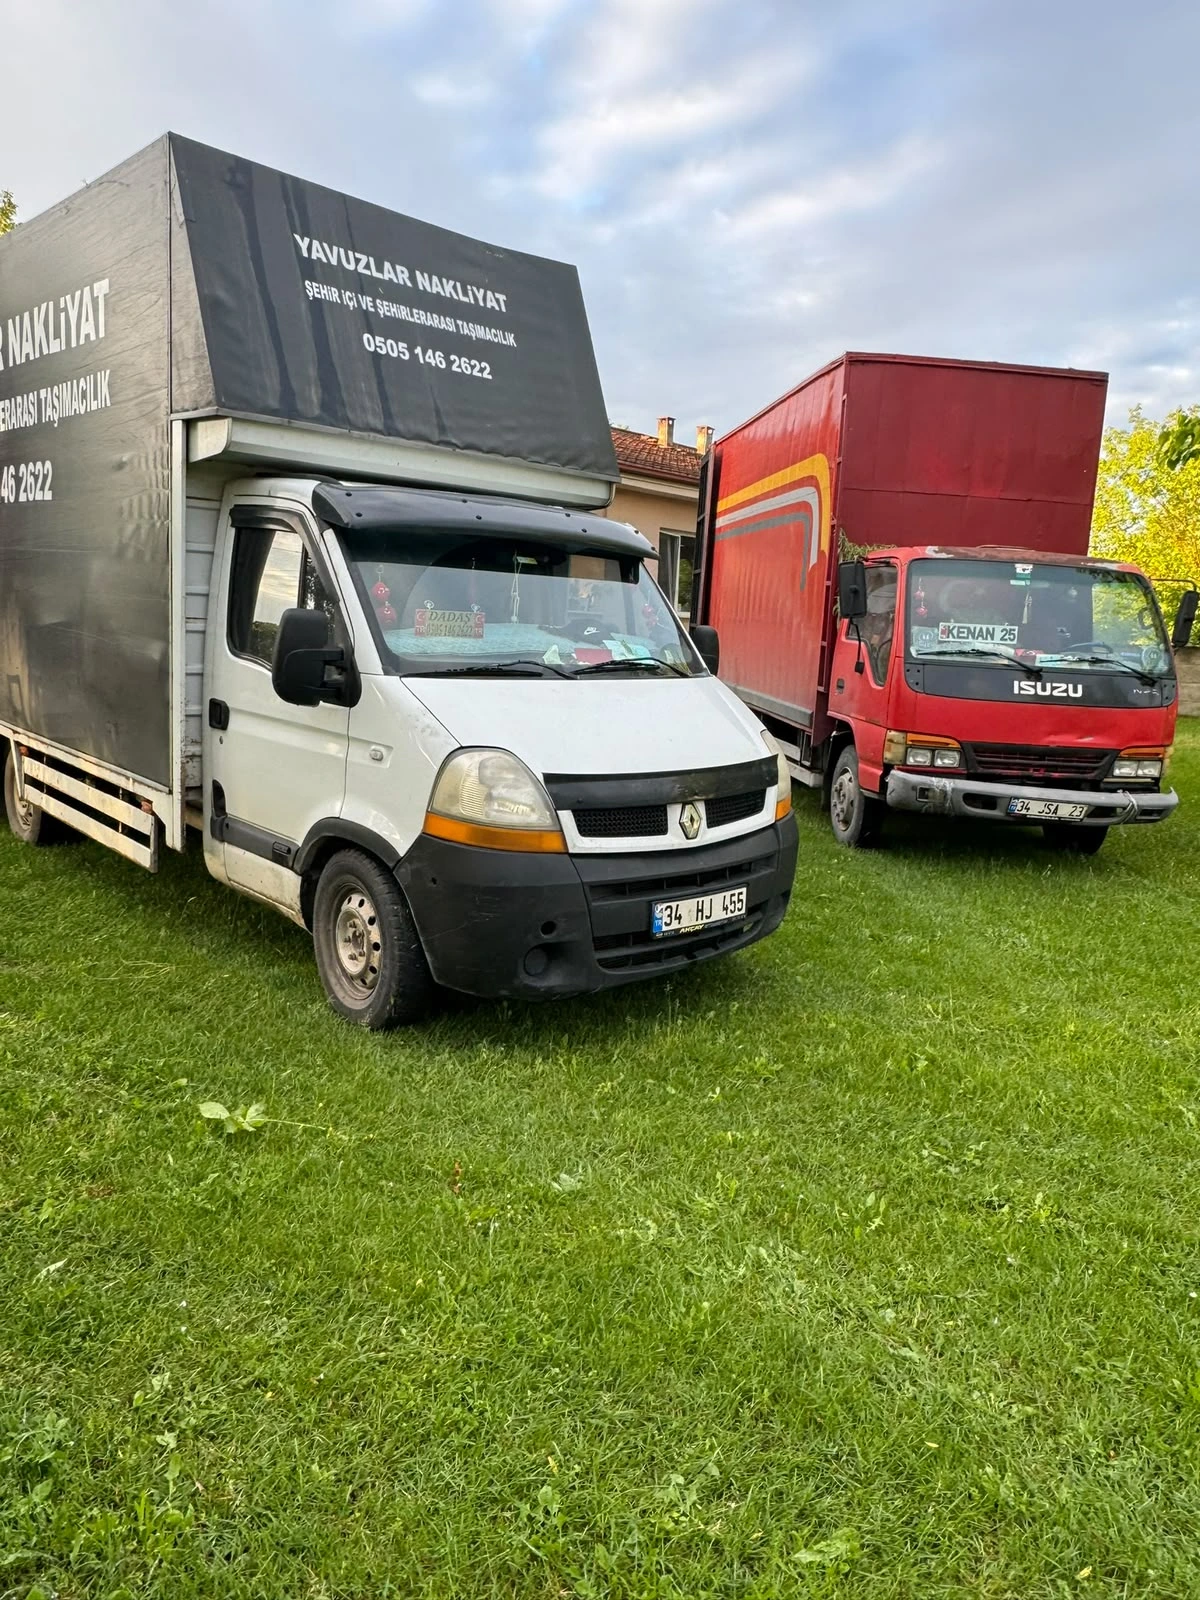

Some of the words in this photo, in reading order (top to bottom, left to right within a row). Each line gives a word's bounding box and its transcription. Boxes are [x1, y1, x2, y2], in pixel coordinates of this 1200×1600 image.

[293, 233, 412, 287] YAVUZLAR
[358, 294, 375, 312] VE
[456, 319, 518, 348] TAŞIMACILIK
[363, 333, 410, 361] 0505
[415, 346, 446, 369] 146
[450, 354, 493, 379] 2622
[40, 369, 111, 427] TAŞIMACILIK
[19, 460, 53, 502] 2622
[947, 625, 996, 641] KENAN
[1000, 628, 1017, 642] 25
[1013, 680, 1083, 698] ISUZU
[1017, 800, 1031, 813] 34
[1037, 803, 1060, 816] JSA
[1068, 805, 1085, 817] 23
[664, 903, 682, 927] 34
[696, 898, 713, 921] HJ
[722, 891, 744, 915] 455
